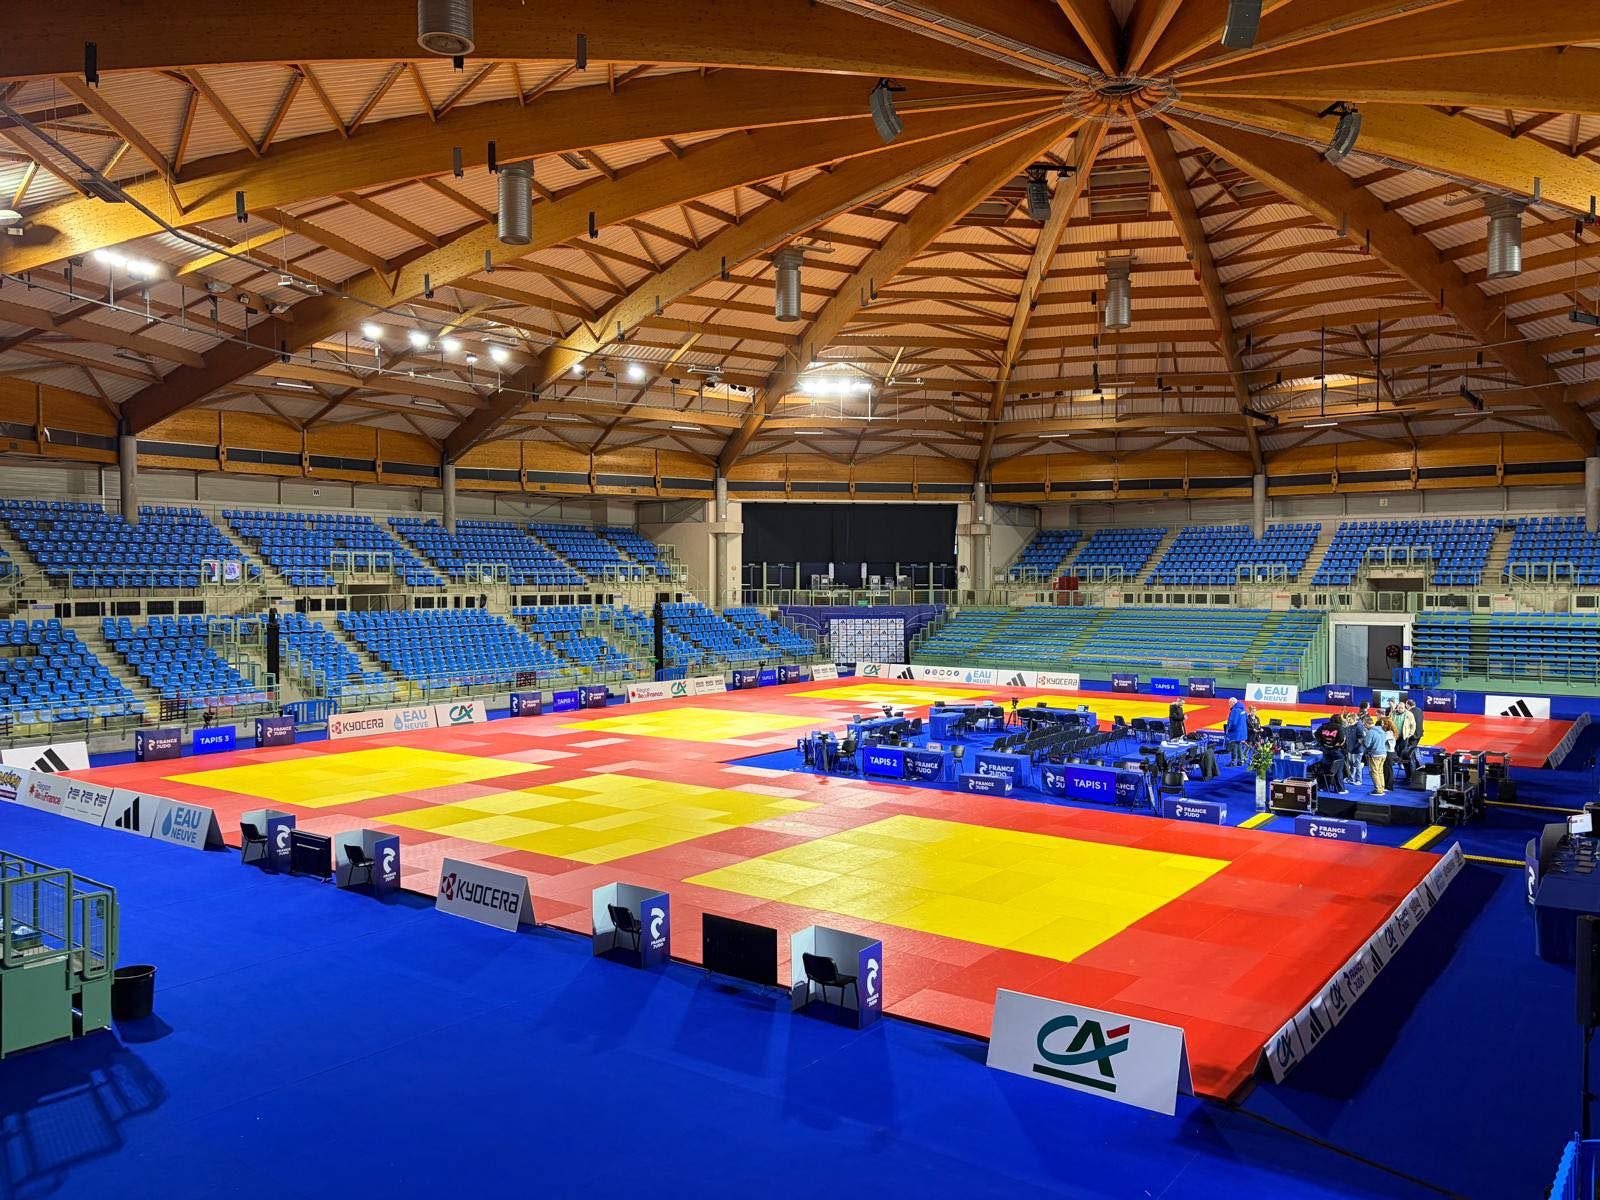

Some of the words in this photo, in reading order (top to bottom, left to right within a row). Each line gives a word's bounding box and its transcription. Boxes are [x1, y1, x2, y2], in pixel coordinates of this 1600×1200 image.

[973, 670, 991, 678] EAU
[1046, 677, 1078, 686] KYOCERA
[671, 680, 687, 695] CA
[1264, 686, 1289, 696] EAU
[403, 709, 428, 722] EAU
[449, 703, 474, 722] CA
[342, 717, 384, 732] KYOCERA
[404, 720, 430, 730] NEUVE
[200, 736, 224, 745] TAPIS
[870, 756, 892, 766] TAPIS
[892, 759, 897, 767] 2
[915, 761, 938, 769] FRANCE
[988, 764, 1015, 773] FRANCE
[1074, 778, 1101, 790] TAPIS
[1103, 782, 1107, 790] 1
[174, 807, 202, 829] EAU
[170, 826, 198, 843] NEUVE
[1319, 825, 1346, 834] FRANCE
[456, 879, 520, 914] KYOCERA
[1037, 1015, 1131, 1079] CA
